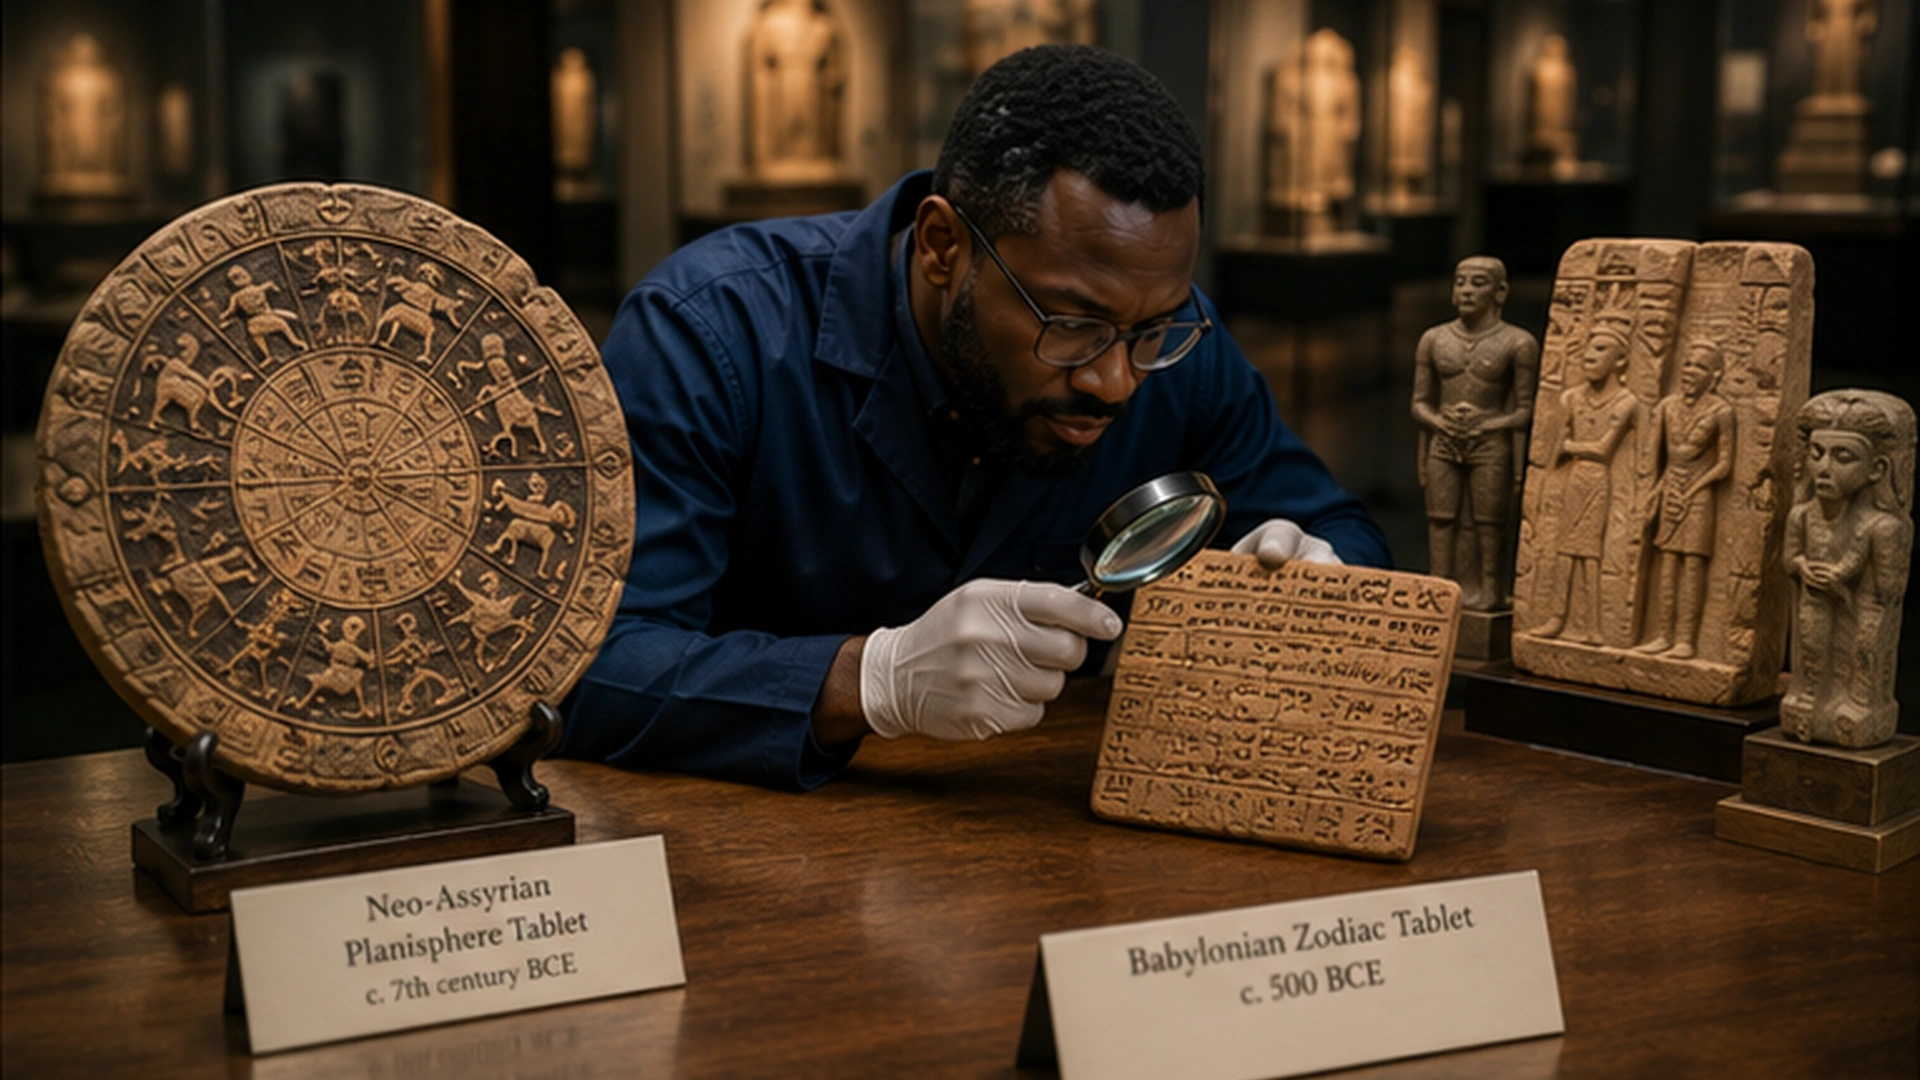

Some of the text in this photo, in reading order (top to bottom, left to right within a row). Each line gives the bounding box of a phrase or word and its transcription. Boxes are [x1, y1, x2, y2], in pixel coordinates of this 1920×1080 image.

[366, 875, 551, 923] Neo-Assyrian
[344, 911, 588, 968] Planisphere Tablet
[1128, 903, 1475, 978] Babylonian Zodiac Tablet
[365, 952, 577, 1006] c. 7th century BCE
[1239, 960, 1385, 1006] c. 500 BCE
